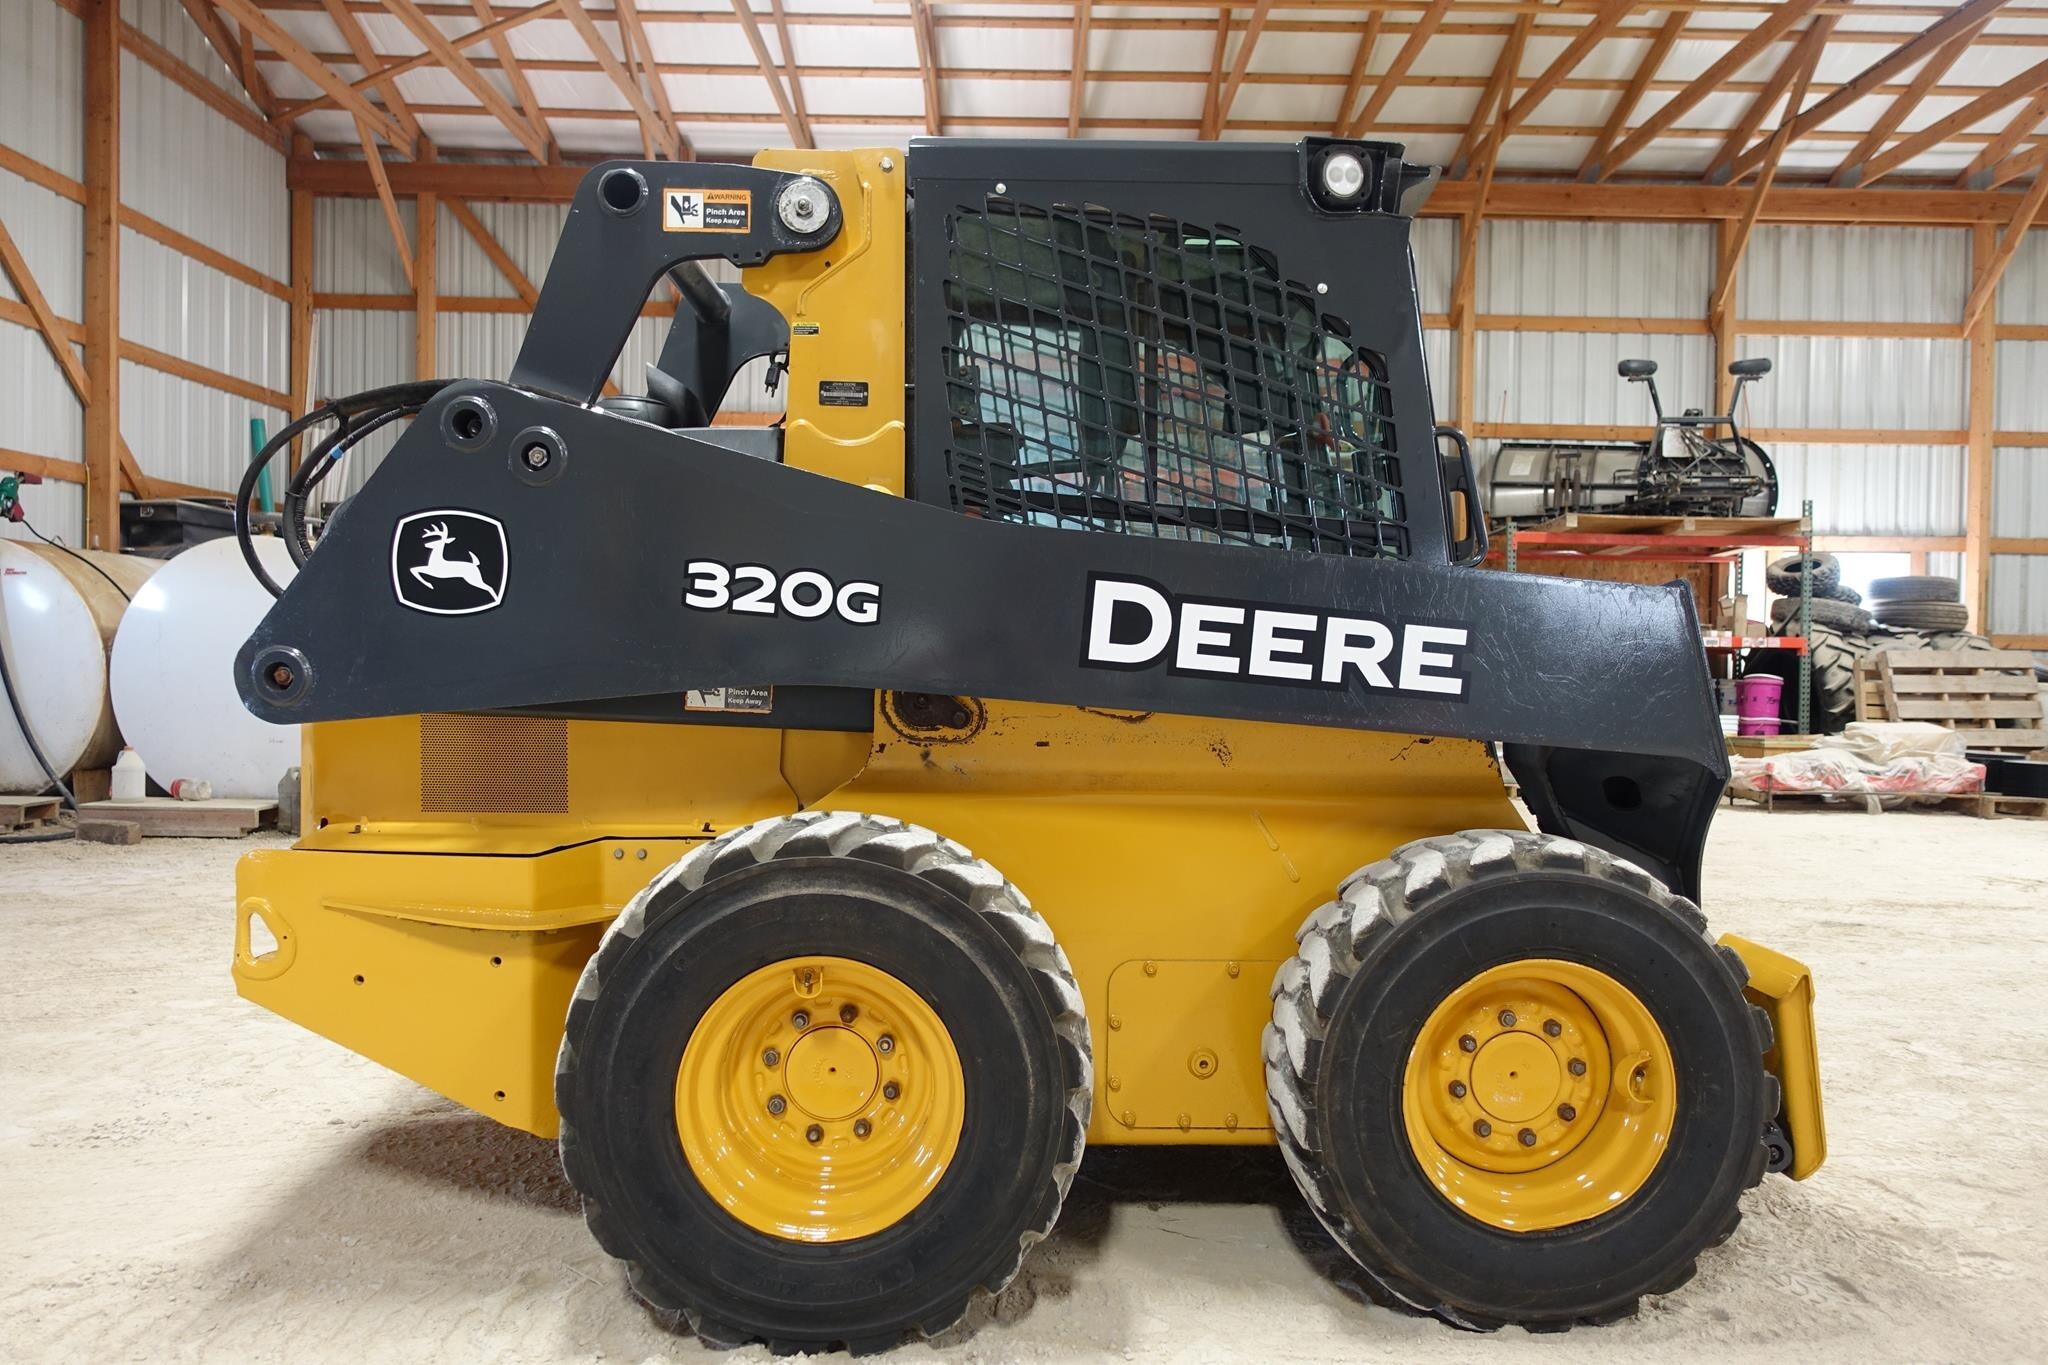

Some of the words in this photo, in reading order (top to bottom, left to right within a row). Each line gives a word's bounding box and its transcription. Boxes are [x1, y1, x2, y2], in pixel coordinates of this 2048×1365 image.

[714, 193, 747, 201] WARNING
[728, 208, 746, 216] Area
[685, 561, 880, 623] 320G
[1088, 580, 1468, 695] DEERE
[728, 688, 750, 696] Pinch
[750, 689, 768, 697] Area
